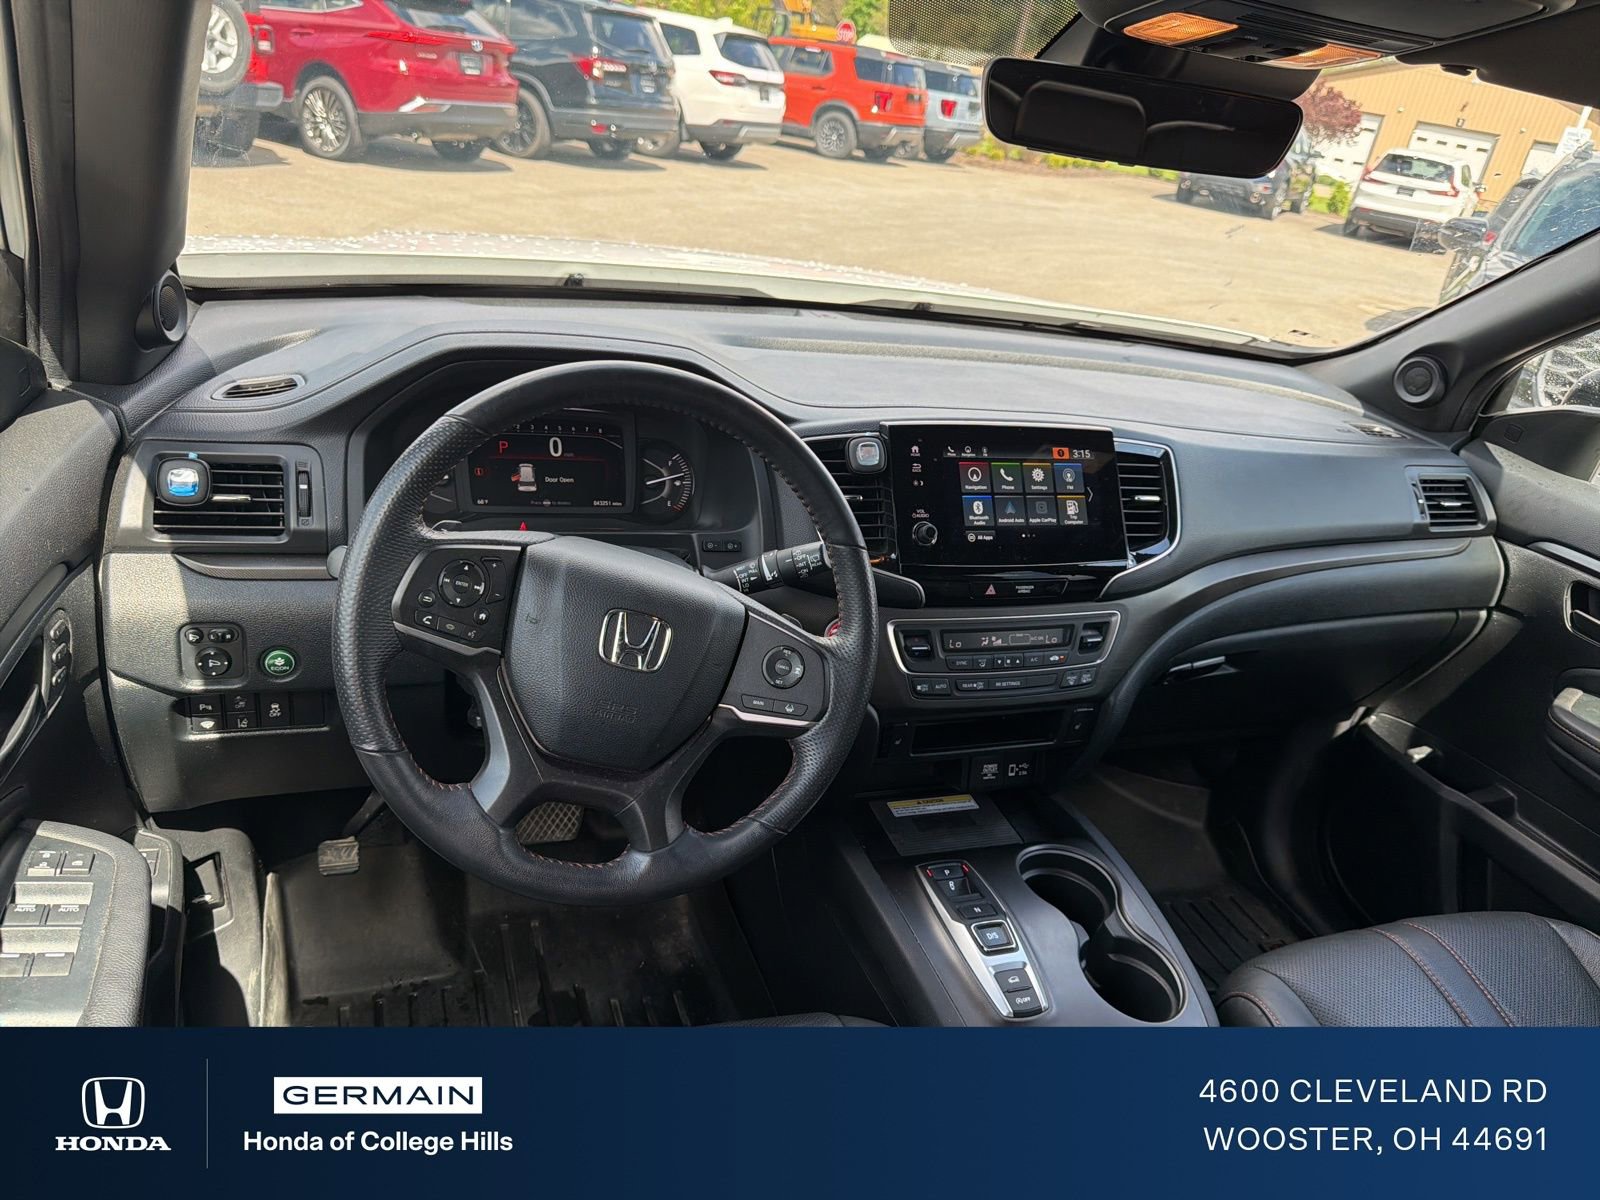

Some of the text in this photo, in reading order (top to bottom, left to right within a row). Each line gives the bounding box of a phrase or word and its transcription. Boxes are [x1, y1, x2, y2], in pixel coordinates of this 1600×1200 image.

[499, 440, 509, 454] P
[549, 436, 563, 457] 0
[1072, 449, 1091, 459] 3:15
[559, 476, 575, 484] Open
[986, 932, 999, 940] D/S
